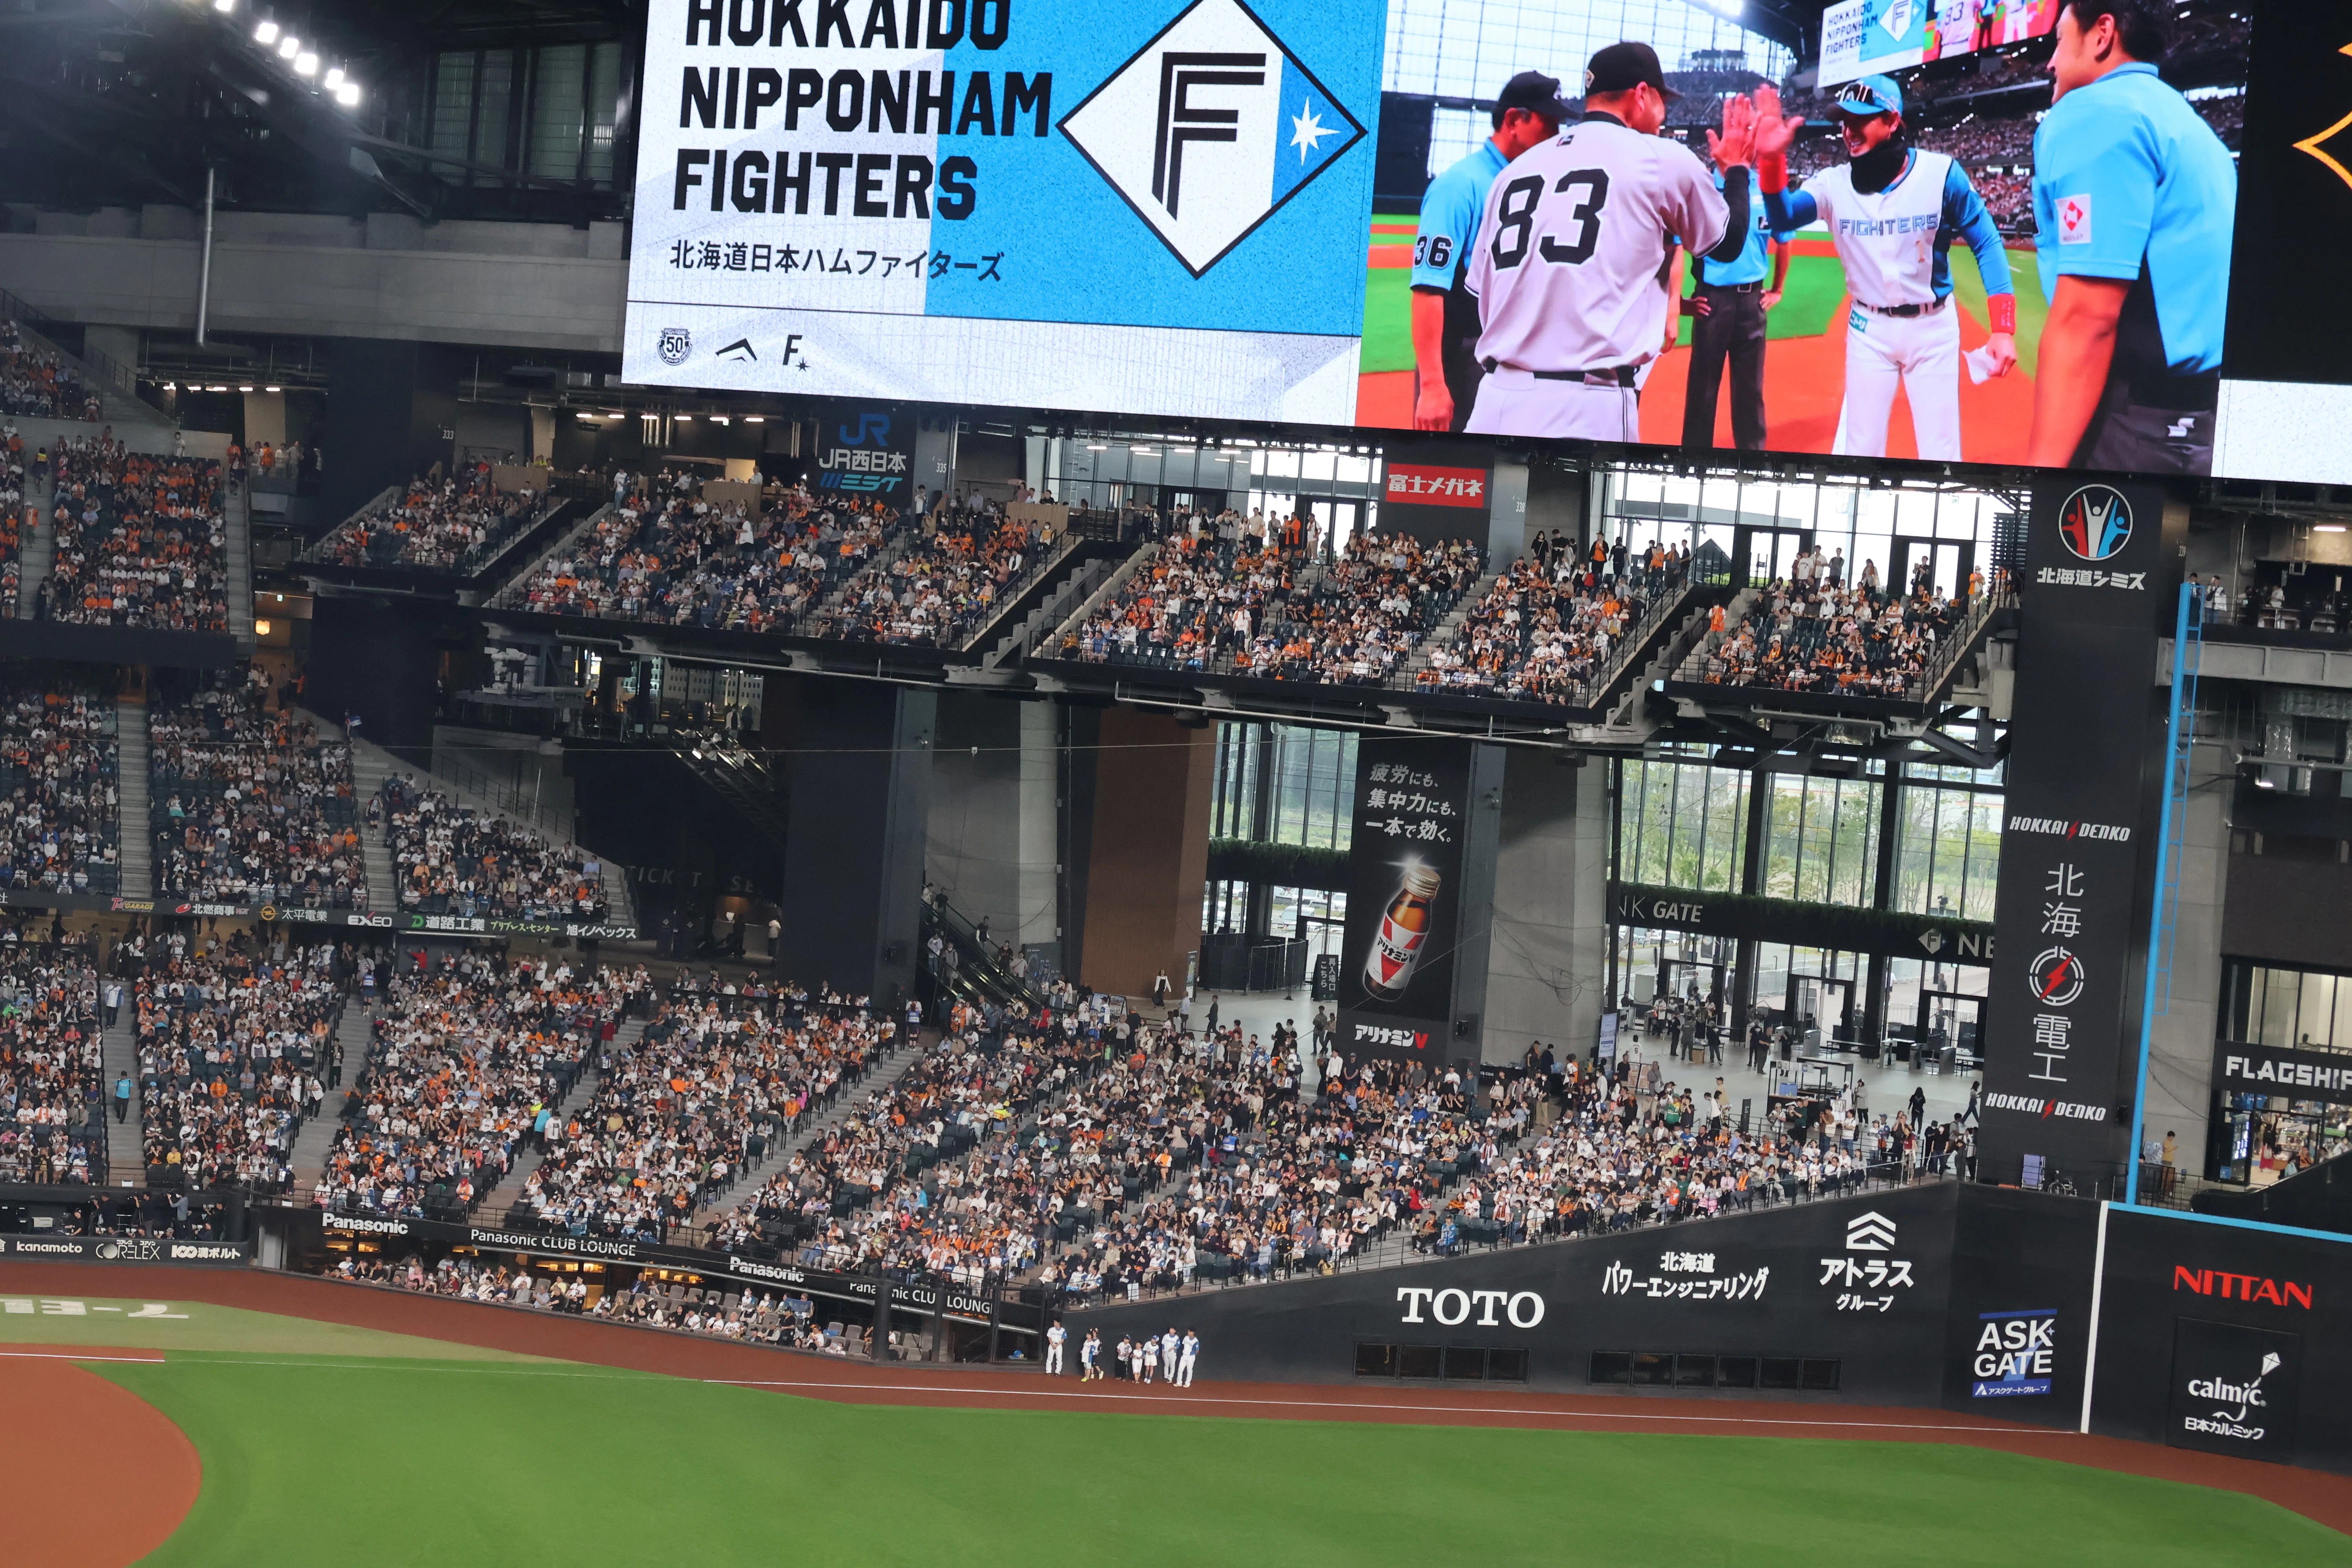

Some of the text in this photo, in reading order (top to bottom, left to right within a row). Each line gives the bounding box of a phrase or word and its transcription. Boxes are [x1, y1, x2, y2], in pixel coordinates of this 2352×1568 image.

[686, 0, 1010, 50] HOKKAIDO
[1828, 1, 1873, 27] HOKKAIDO
[1826, 15, 1878, 41] NIPPONHAM
[1826, 33, 1867, 55] FIGHTERS
[681, 67, 1052, 136] NIPPONHAM
[1152, 52, 1266, 221] F
[674, 149, 976, 220] FIGHTERS
[1490, 167, 1612, 271] 83
[1839, 214, 1938, 236] FIGHTERS
[669, 240, 1005, 282] 北海道日本ハムファイターズ
[1414, 234, 1454, 269] 36
[666, 336, 683, 353] 50
[839, 413, 890, 446] JR
[819, 448, 906, 473] JR西日本
[936, 462, 947, 473] 335
[1388, 474, 1483, 497] 富士メガネ
[1515, 502, 1525, 512] 338
[2037, 568, 2146, 590] 北海道シミズ
[1370, 762, 1439, 787] 疲労にも、
[1367, 789, 1457, 816] 集中力にも、
[1366, 817, 1450, 842] 一本で効く。
[2009, 817, 2130, 841] HOKKAI DENKO
[281, 908, 327, 922] 太平電業
[348, 912, 392, 927] EXEO
[424, 914, 485, 933] 道路工業
[1653, 900, 1703, 922] GATE
[566, 922, 636, 938] 旭イノベックス
[1377, 936, 1416, 963] アリナミンV
[1354, 1024, 1428, 1048] アリナミンV
[1985, 1093, 2106, 1120] HOKKAI DENKO
[323, 1211, 408, 1236] Panasonic
[13, 1241, 83, 1254] kanamoto
[96, 1243, 160, 1260] CORELEX
[172, 1245, 240, 1259] 100満ボルト
[471, 1229, 637, 1258] Panasonic CLUB LOUNGE
[730, 1256, 804, 1283] Panasonic
[1660, 1252, 1715, 1272] 北海道
[1820, 1258, 1914, 1287] アトラス
[1602, 1259, 1769, 1300] パワーエンジニアリング
[2174, 1265, 2312, 1309] NITTAN
[850, 1283, 908, 1299] Pananic
[913, 1290, 936, 1304] CLU
[1837, 1294, 1894, 1312] グループ
[1397, 1288, 1544, 1328] TOTO
[1976, 1319, 2054, 1348] ASK
[1974, 1350, 2052, 1377] GATE
[1989, 1385, 2047, 1395] アスクゲートグループ
[2188, 1376, 2262, 1405] calmic
[2185, 1416, 2264, 1439] 日本カルミック
